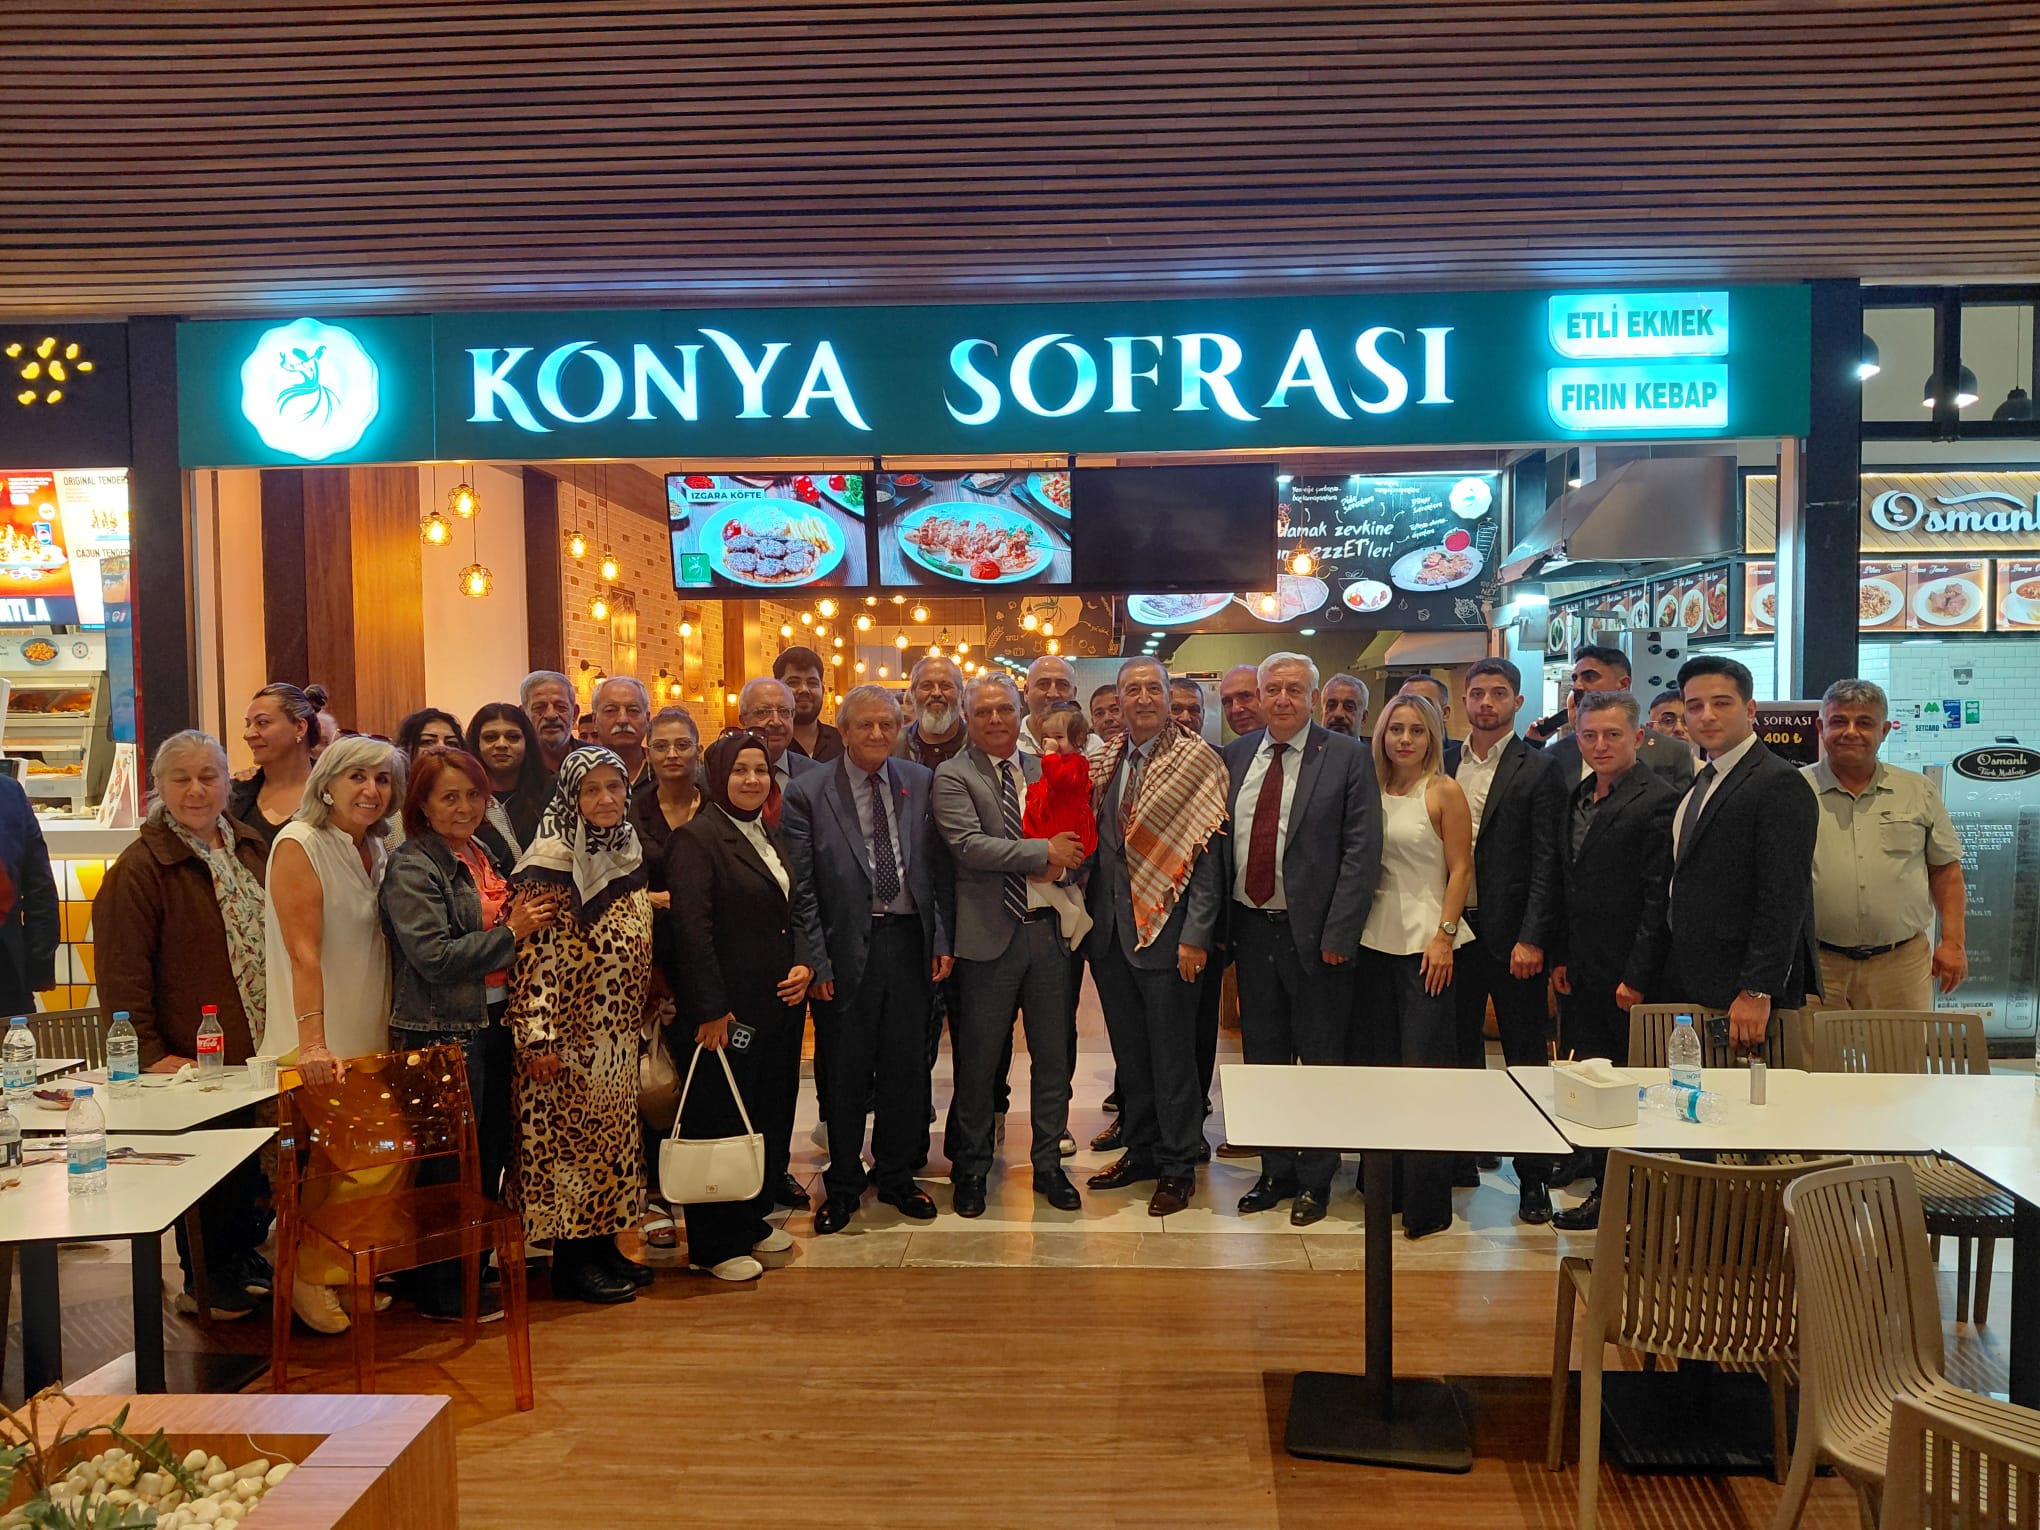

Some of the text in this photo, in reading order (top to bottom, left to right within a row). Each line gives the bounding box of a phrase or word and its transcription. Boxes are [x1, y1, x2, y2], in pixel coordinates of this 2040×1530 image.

[1566, 303, 1714, 339] ETLİ EKMEK
[464, 326, 1455, 433] KONYA SOFRASI
[1561, 381, 1718, 411] FIRIN KEBAP
[63, 475, 96, 486] ORIGINAL
[691, 489, 762, 500] IZGARA KÖFTE
[1334, 519, 1394, 537] zevkine
[76, 549, 100, 558] CAJUN
[1763, 716, 1812, 726] SOFRASI
[1763, 732, 1790, 744] 400
